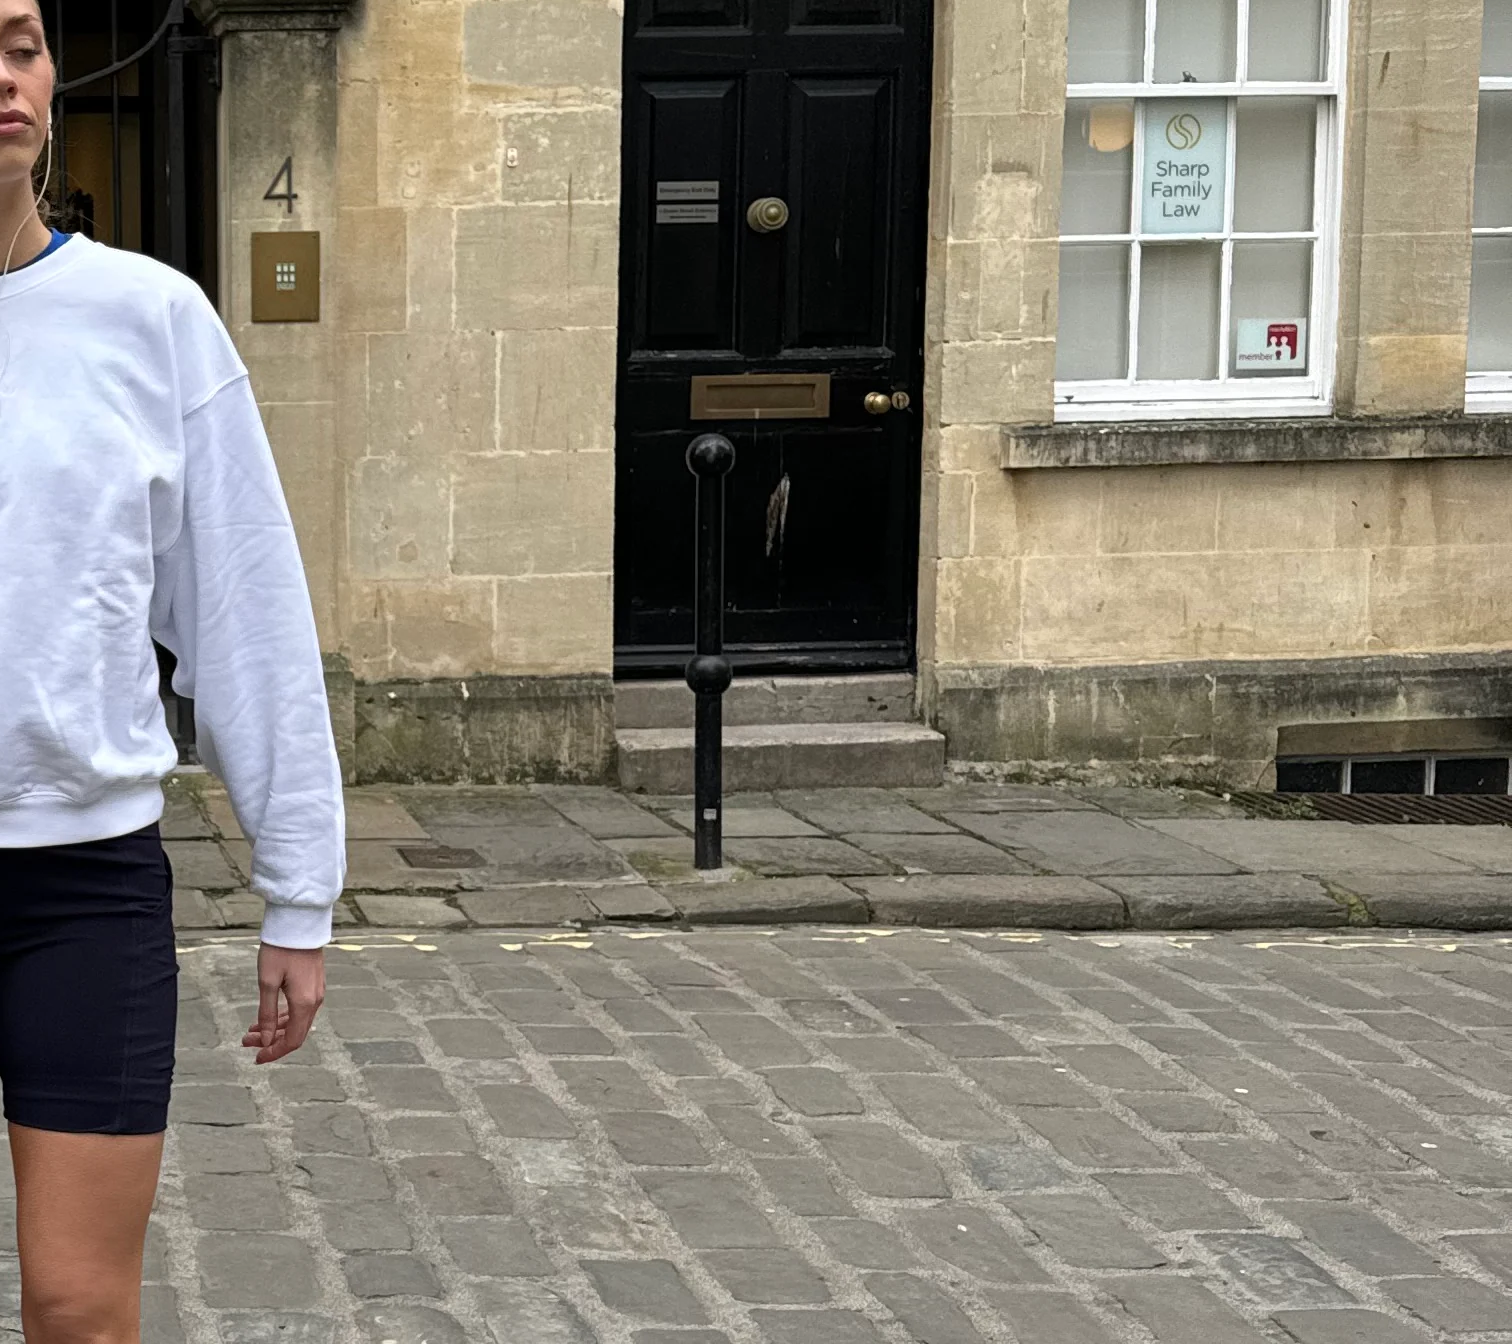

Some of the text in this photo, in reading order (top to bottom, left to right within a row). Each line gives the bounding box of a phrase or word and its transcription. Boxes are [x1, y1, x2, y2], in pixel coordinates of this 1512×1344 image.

[1156, 160, 1209, 179] Sharp
[263, 155, 298, 214] 4
[1152, 181, 1212, 200] Family
[1163, 202, 1200, 217] Law
[1239, 352, 1273, 361] member
